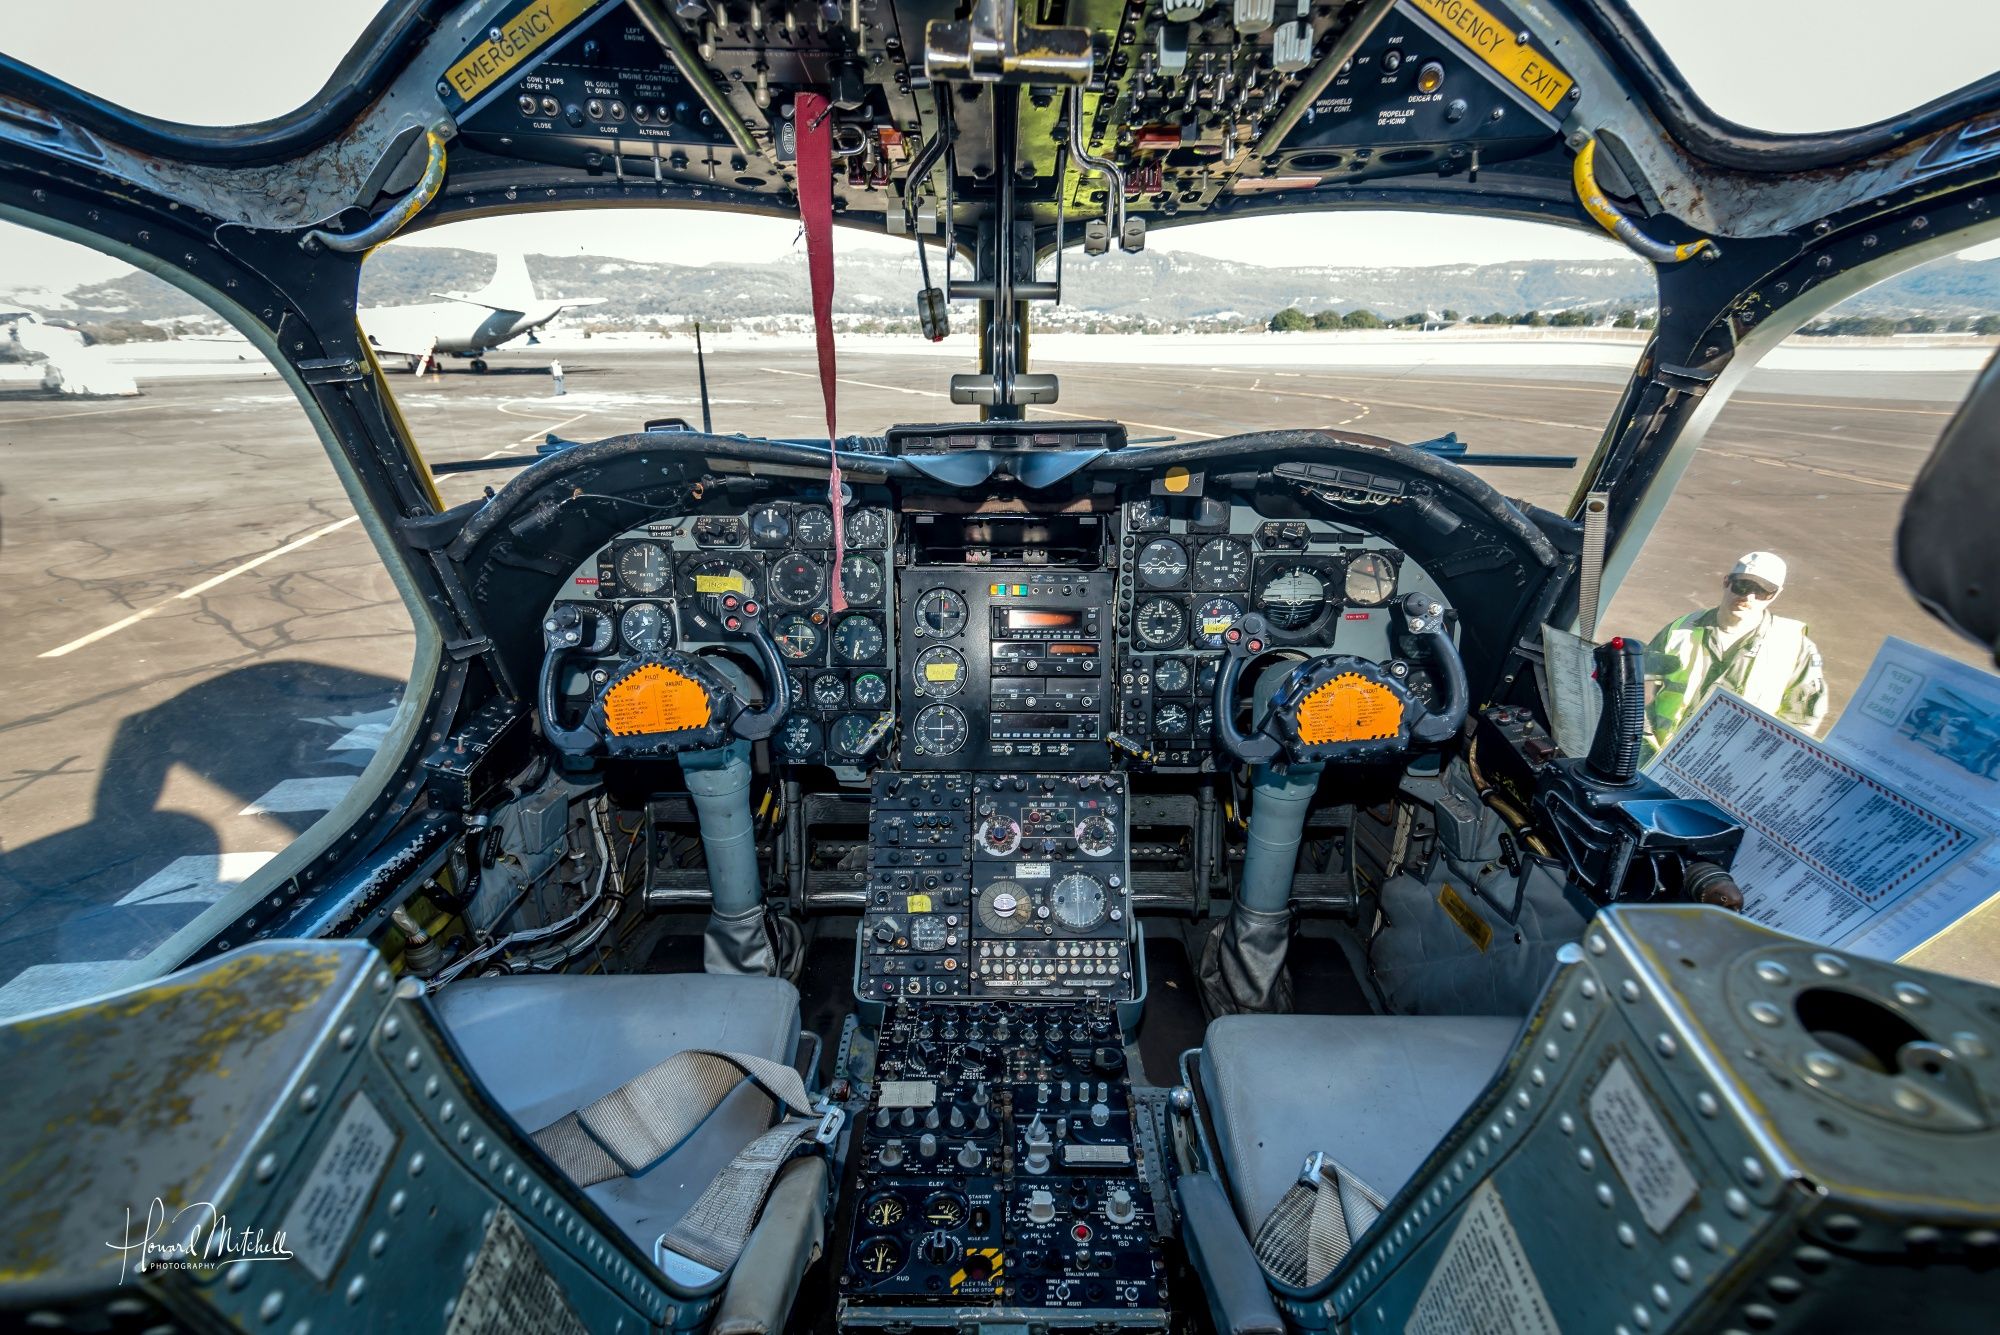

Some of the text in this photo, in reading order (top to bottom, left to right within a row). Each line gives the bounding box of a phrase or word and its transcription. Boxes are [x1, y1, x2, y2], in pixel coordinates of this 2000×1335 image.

[624, 34, 645, 42] ENGINE
[454, 4, 555, 92] EMERGENCY
[545, 77, 564, 85] FLAPS
[619, 73, 679, 83] ENGINE CONTROLS
[1520, 62, 1563, 100] EXIT
[1316, 98, 1352, 106] WINDSHIELD
[1408, 95, 1431, 103] DEICER
[1316, 106, 1332, 114] HEAT
[1379, 109, 1415, 118] PROPELLER
